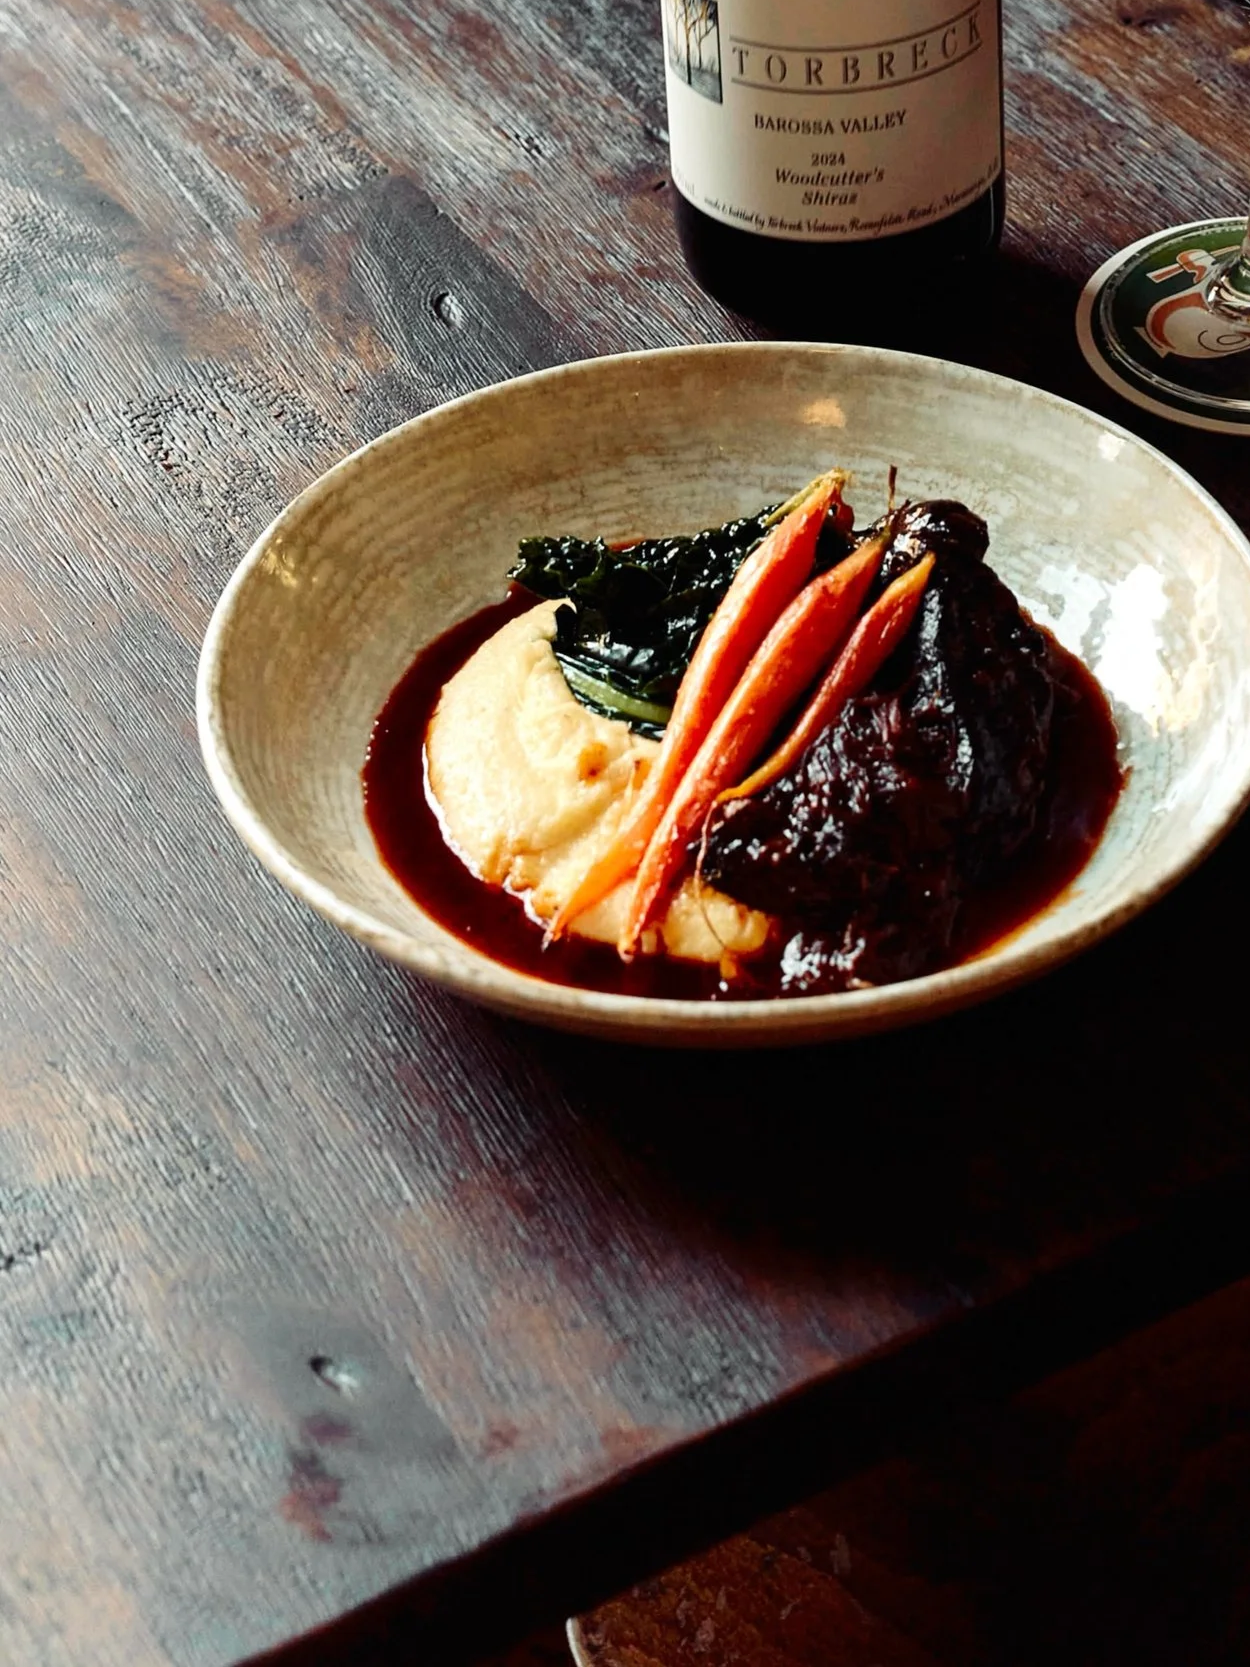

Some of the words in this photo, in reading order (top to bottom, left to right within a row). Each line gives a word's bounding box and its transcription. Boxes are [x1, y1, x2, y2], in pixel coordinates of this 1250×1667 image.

[731, 13, 982, 86] TORBRECK
[754, 113, 834, 135] BAROSSA
[840, 108, 907, 134] VALLEY
[811, 151, 846, 167] 2024
[775, 166, 885, 187] Woodcutter's
[801, 190, 858, 206] Shiraz
